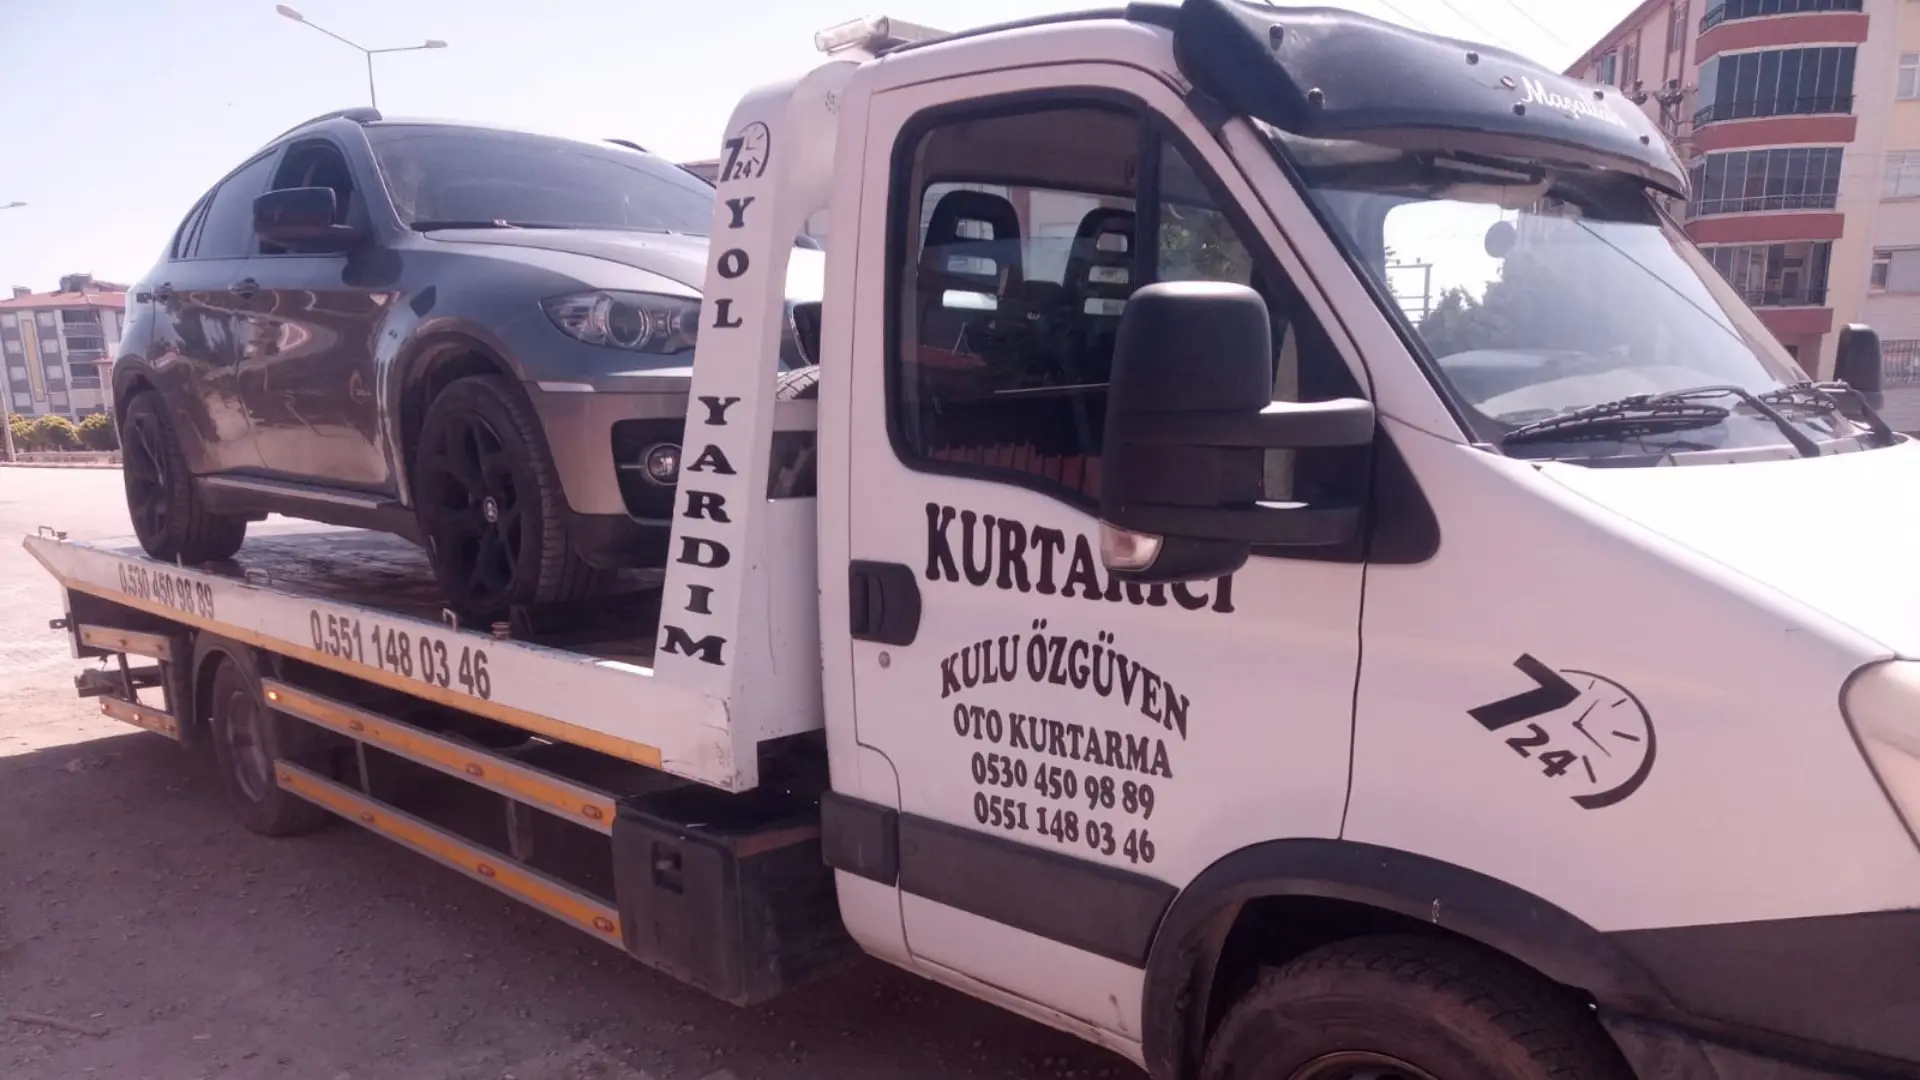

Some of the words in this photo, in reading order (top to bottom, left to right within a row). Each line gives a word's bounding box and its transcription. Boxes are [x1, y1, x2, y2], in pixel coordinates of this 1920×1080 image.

[712, 197, 755, 328] YOL
[660, 396, 741, 666] YARDIM
[152, 570, 175, 608] 450
[176, 575, 195, 614] 98
[195, 581, 214, 620] 89
[310, 609, 364, 664] 0.551
[371, 624, 413, 677] 148
[419, 636, 450, 688] 03
[459, 645, 491, 700] 46
[940, 635, 1020, 699] KULU
[1026, 619, 1190, 741] ÖZGÜVEN
[953, 703, 1003, 743] OTO
[1009, 713, 1173, 779] KURTARMA
[1505, 723, 1578, 778] 24
[971, 752, 1027, 787] 0530
[1034, 763, 1077, 800] 450
[1084, 775, 1115, 812] 98
[1122, 781, 1155, 821] 89
[974, 792, 1027, 830] 0551
[1036, 807, 1079, 844] 148
[1085, 821, 1115, 856] 03
[1123, 829, 1155, 864] 46
